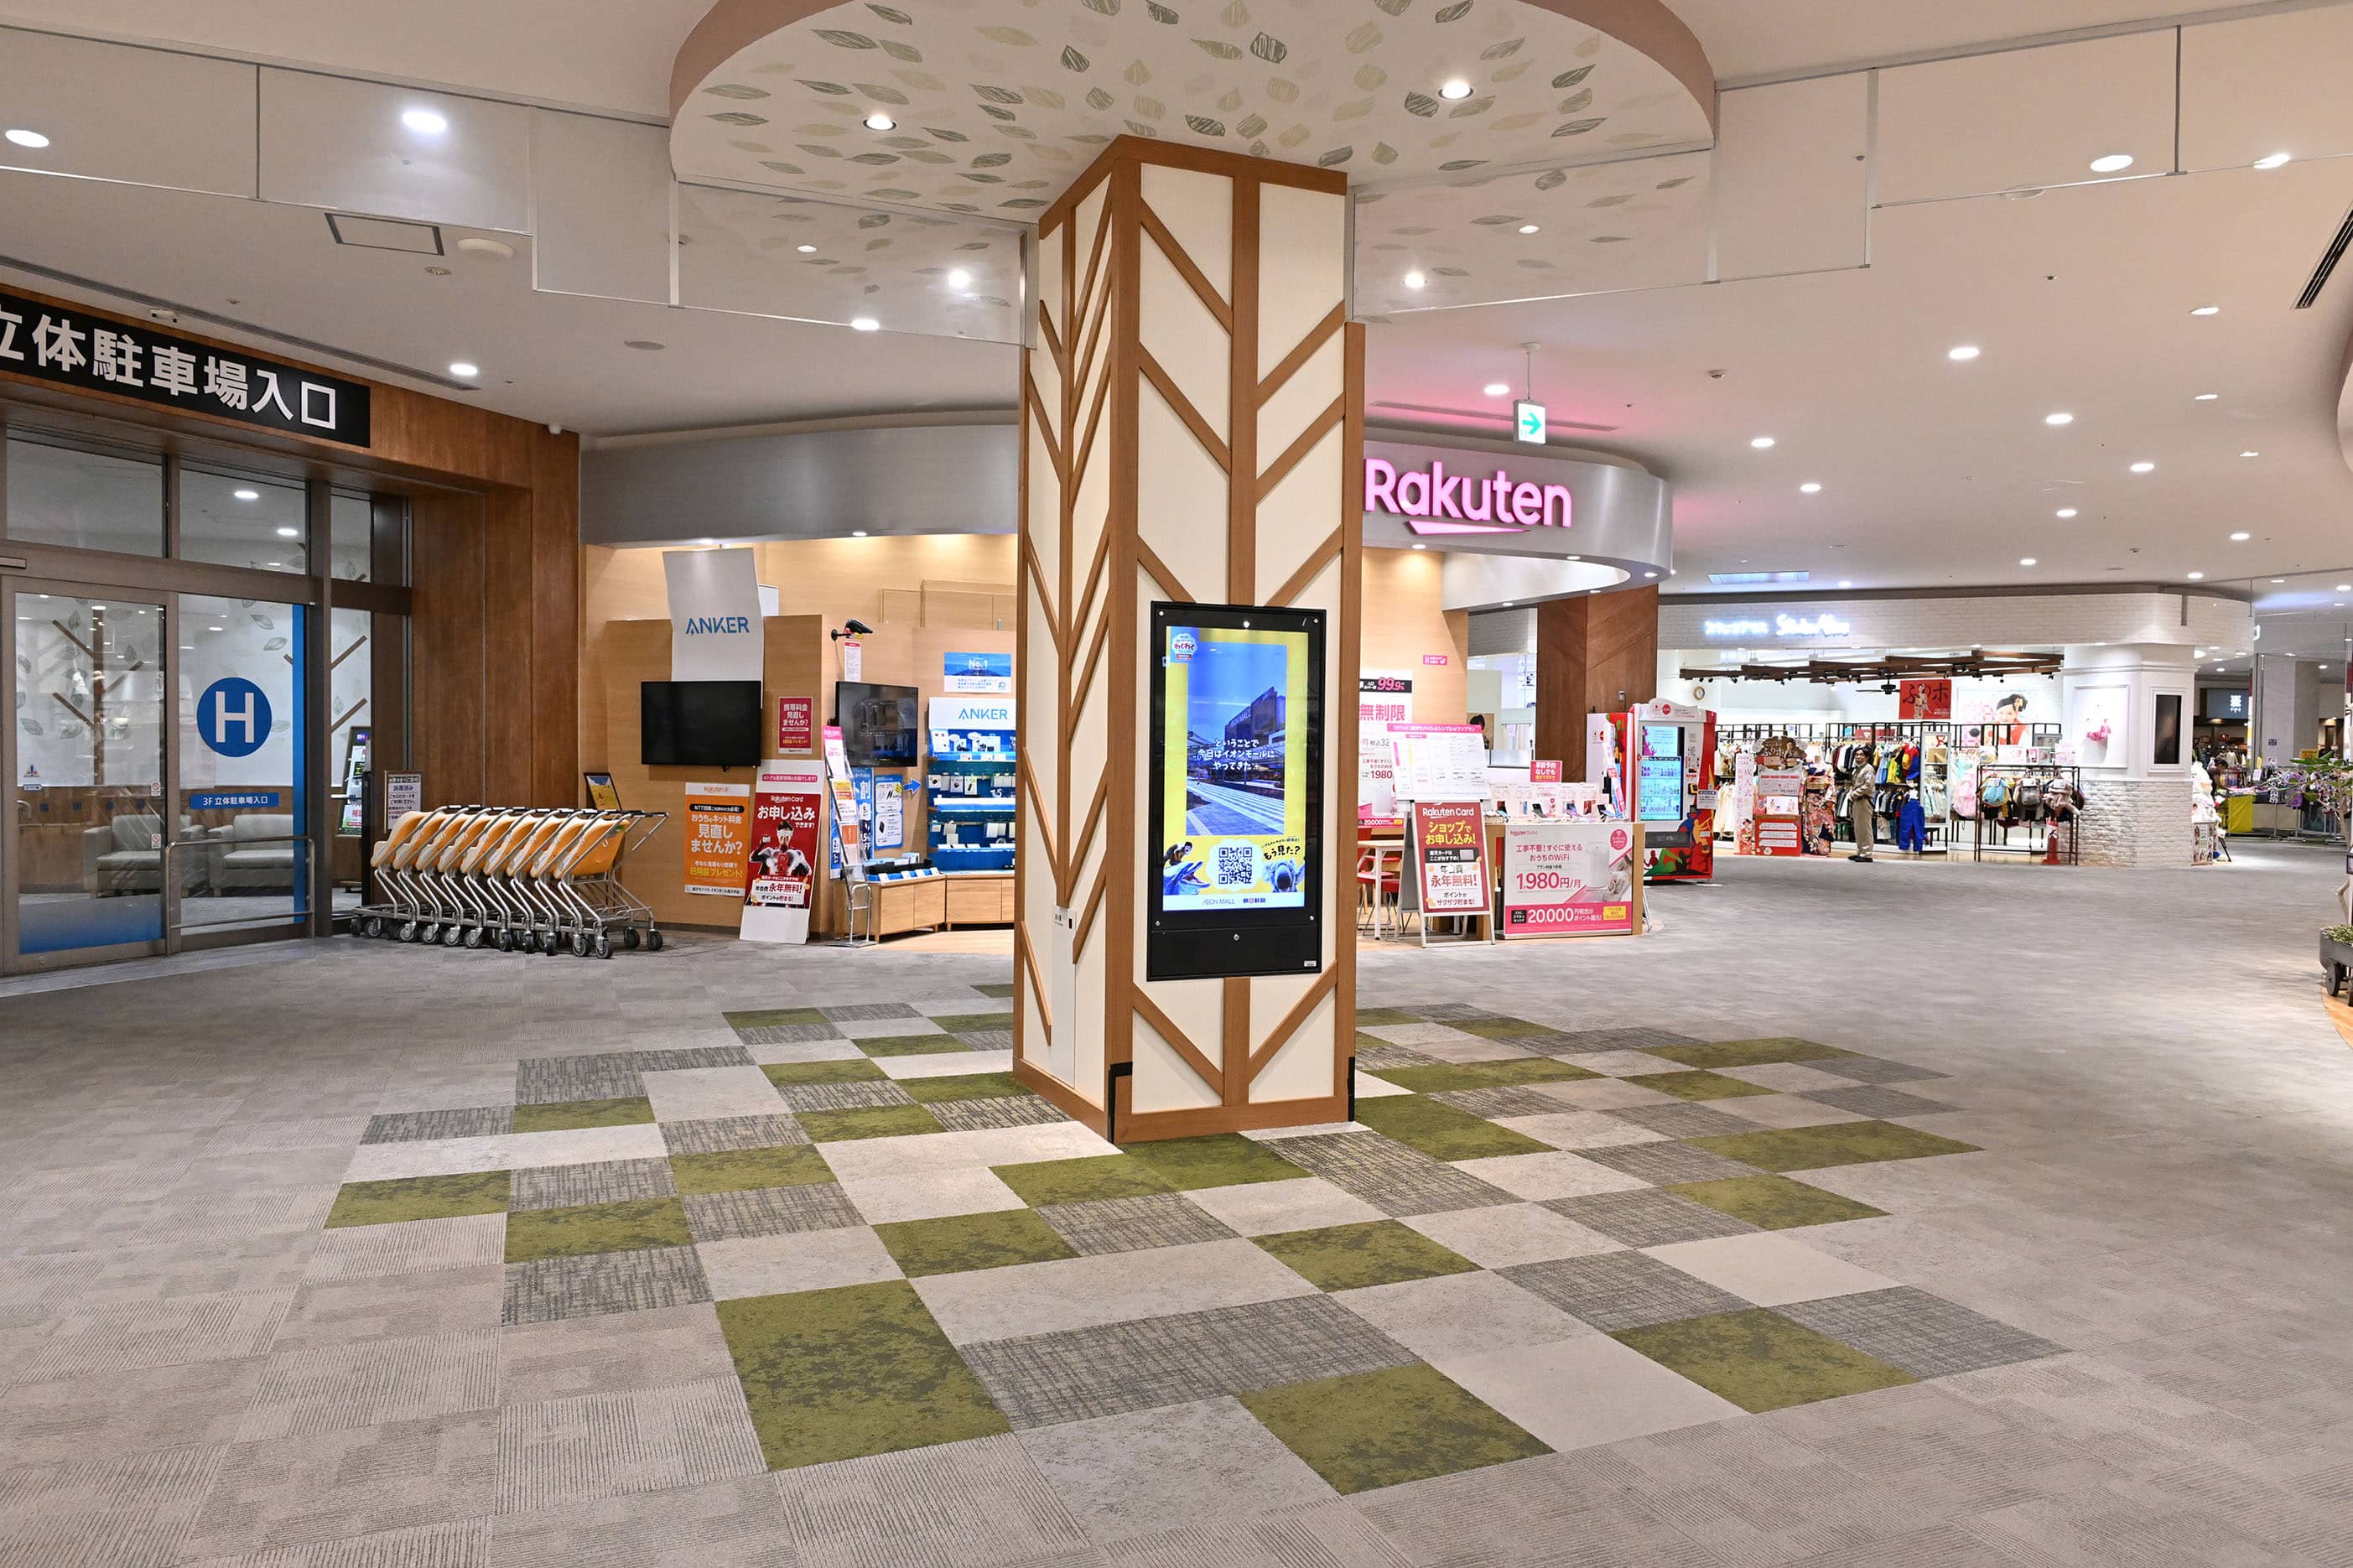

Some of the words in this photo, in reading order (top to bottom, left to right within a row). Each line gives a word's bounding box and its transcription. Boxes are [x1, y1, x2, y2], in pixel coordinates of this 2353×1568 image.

[0, 304, 336, 430] 立体駐車場入口
[1364, 459, 1572, 528] Rakuten
[685, 616, 750, 636] ANKER
[215, 691, 255, 743] H
[958, 708, 1008, 720] ANKER
[1359, 703, 1405, 722] 無制限
[1214, 739, 1260, 748] ということで
[1197, 749, 1275, 759] 今日はイオンモールに
[1213, 761, 1253, 771] やってきた
[203, 797, 213, 806] 3F
[215, 796, 268, 806] 立体駐車場入口
[771, 795, 791, 803] Rakuten
[757, 805, 815, 821] お申し込み
[1422, 807, 1455, 818] Rakuten
[1455, 807, 1474, 817] Card
[698, 823, 734, 839] 見直し
[1428, 821, 1472, 833] ショップで
[1426, 833, 1477, 845] お申し込み!
[690, 839, 743, 855] ませんか?
[1264, 845, 1301, 860] もう見た?
[1529, 854, 1570, 862] おうちのWiFi
[1431, 874, 1478, 887] 永年無料!
[1528, 907, 1574, 924] 20,000
